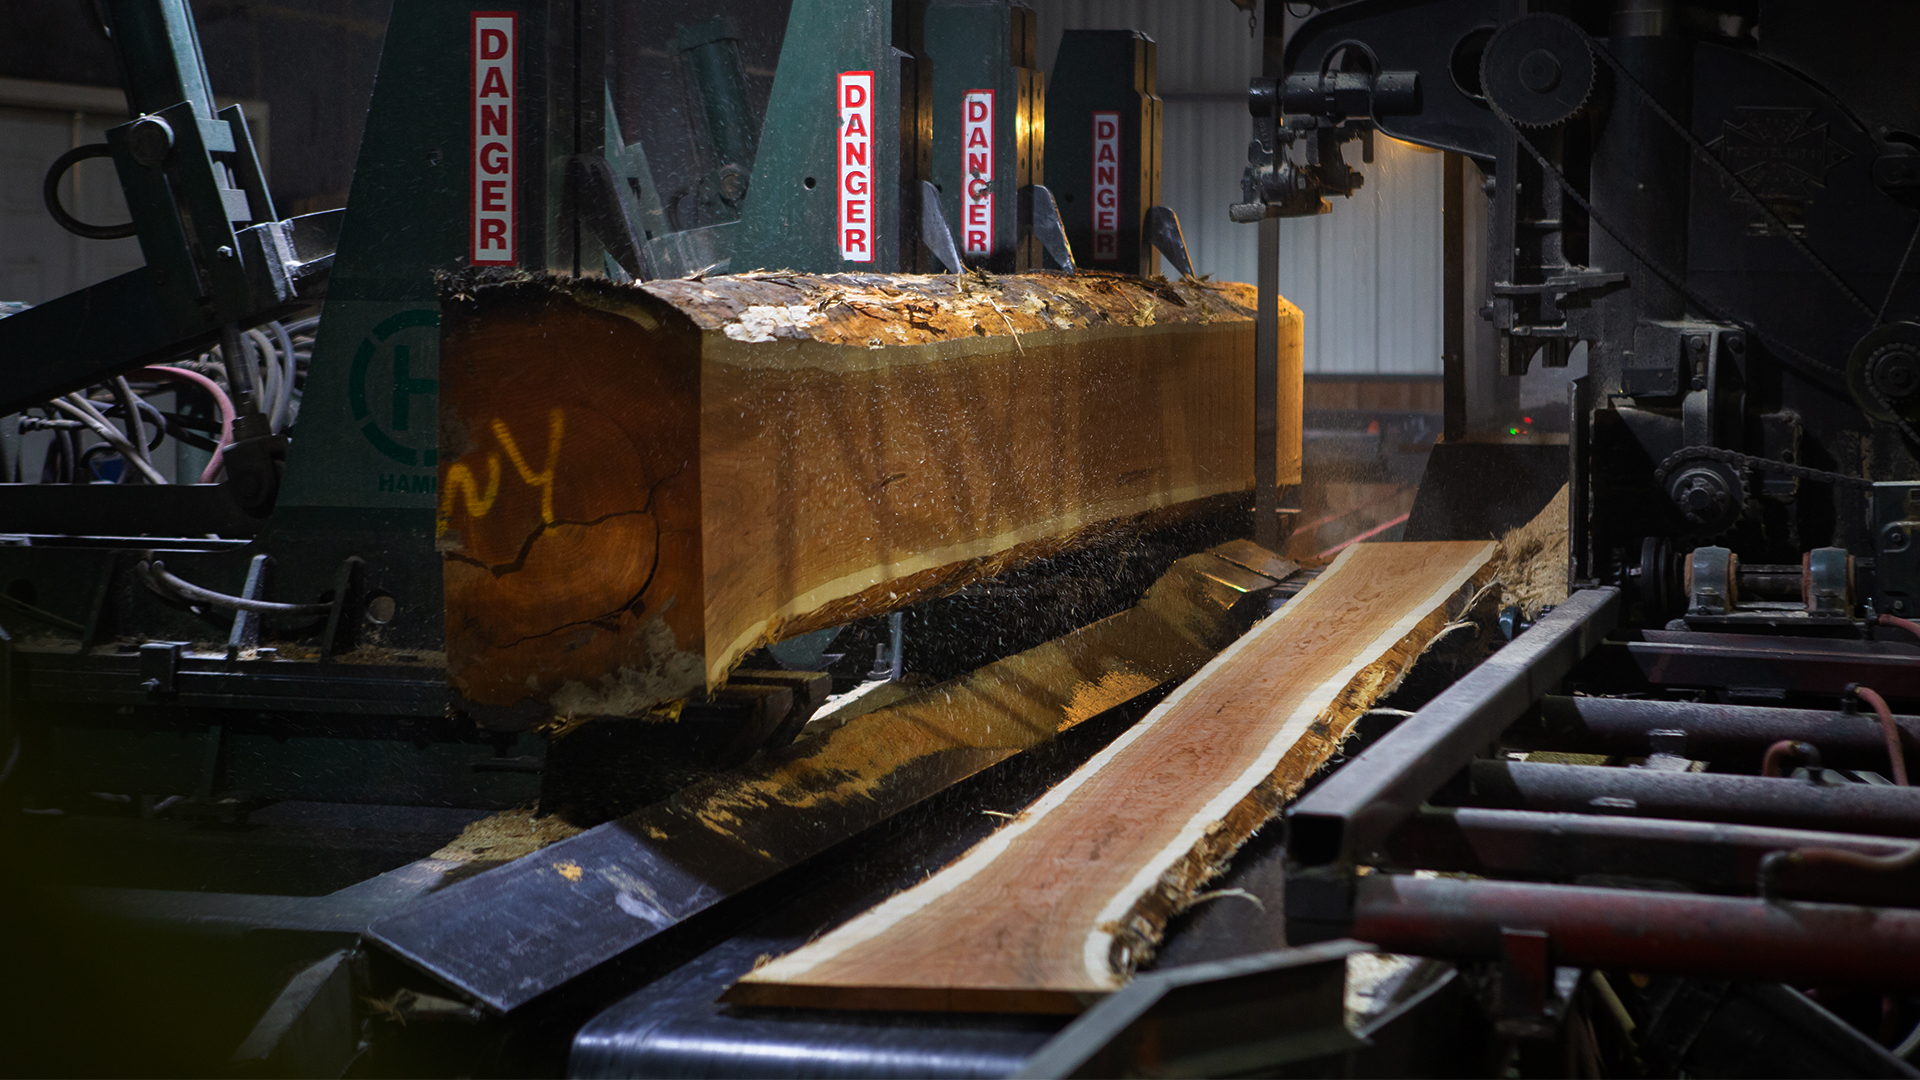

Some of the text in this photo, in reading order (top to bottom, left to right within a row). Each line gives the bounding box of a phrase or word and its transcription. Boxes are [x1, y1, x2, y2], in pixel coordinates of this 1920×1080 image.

[479, 28, 510, 250] DANGER
[844, 84, 868, 253] DANGER
[967, 101, 990, 252] DANGER
[1096, 121, 1117, 254] DANGER
